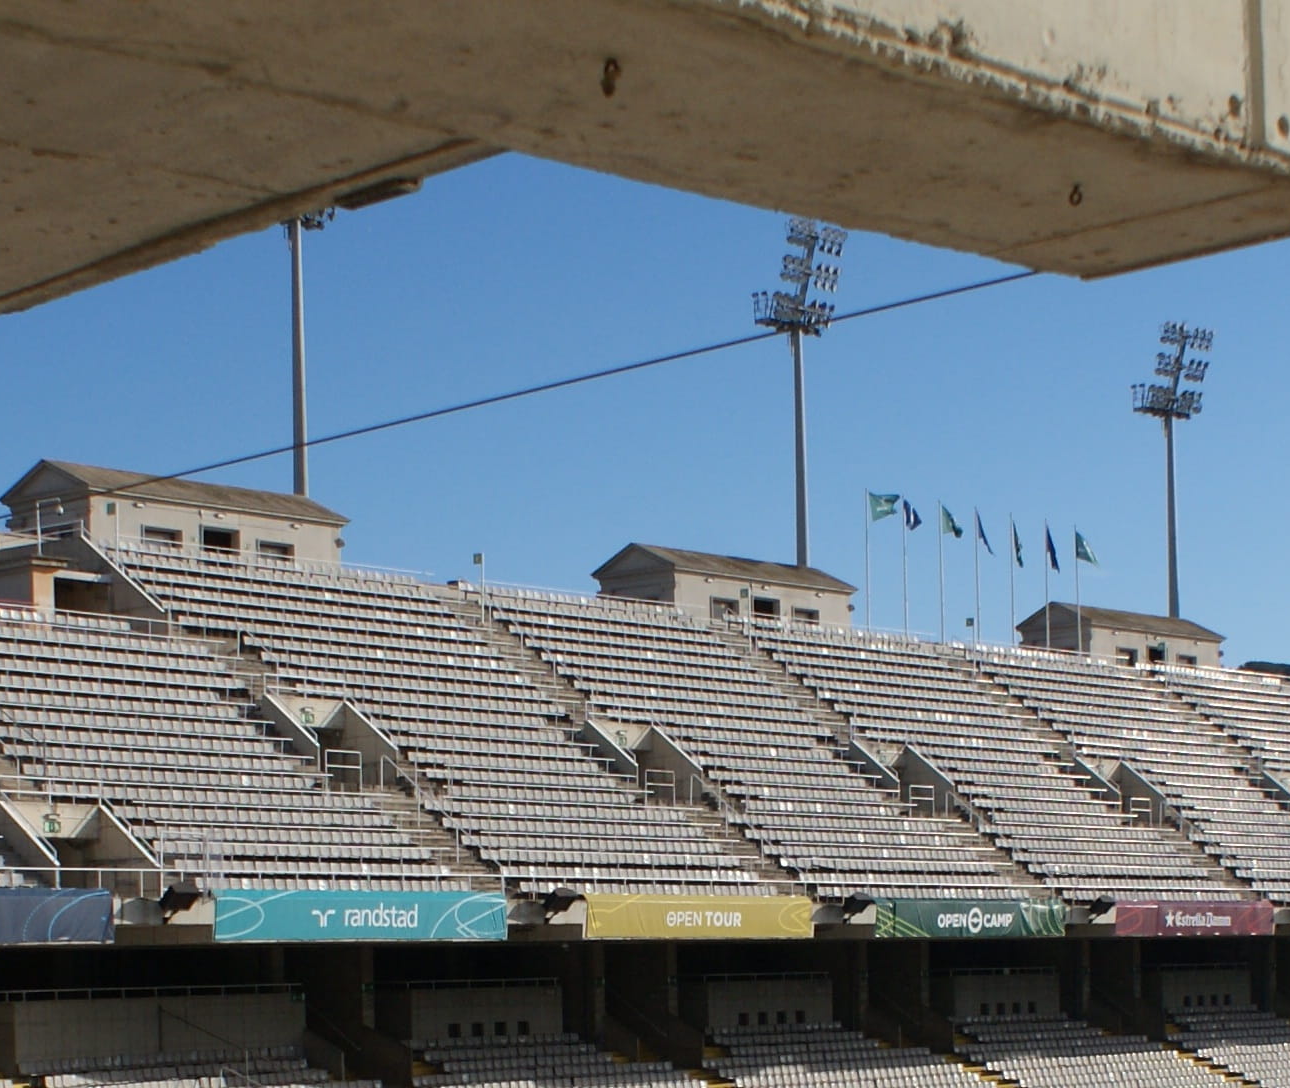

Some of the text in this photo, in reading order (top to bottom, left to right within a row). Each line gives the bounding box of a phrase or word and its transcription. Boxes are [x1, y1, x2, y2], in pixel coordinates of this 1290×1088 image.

[344, 902, 419, 928] randstad
[666, 911, 742, 927] OPEN TOUR
[937, 913, 1013, 928] OPEN CAMP
